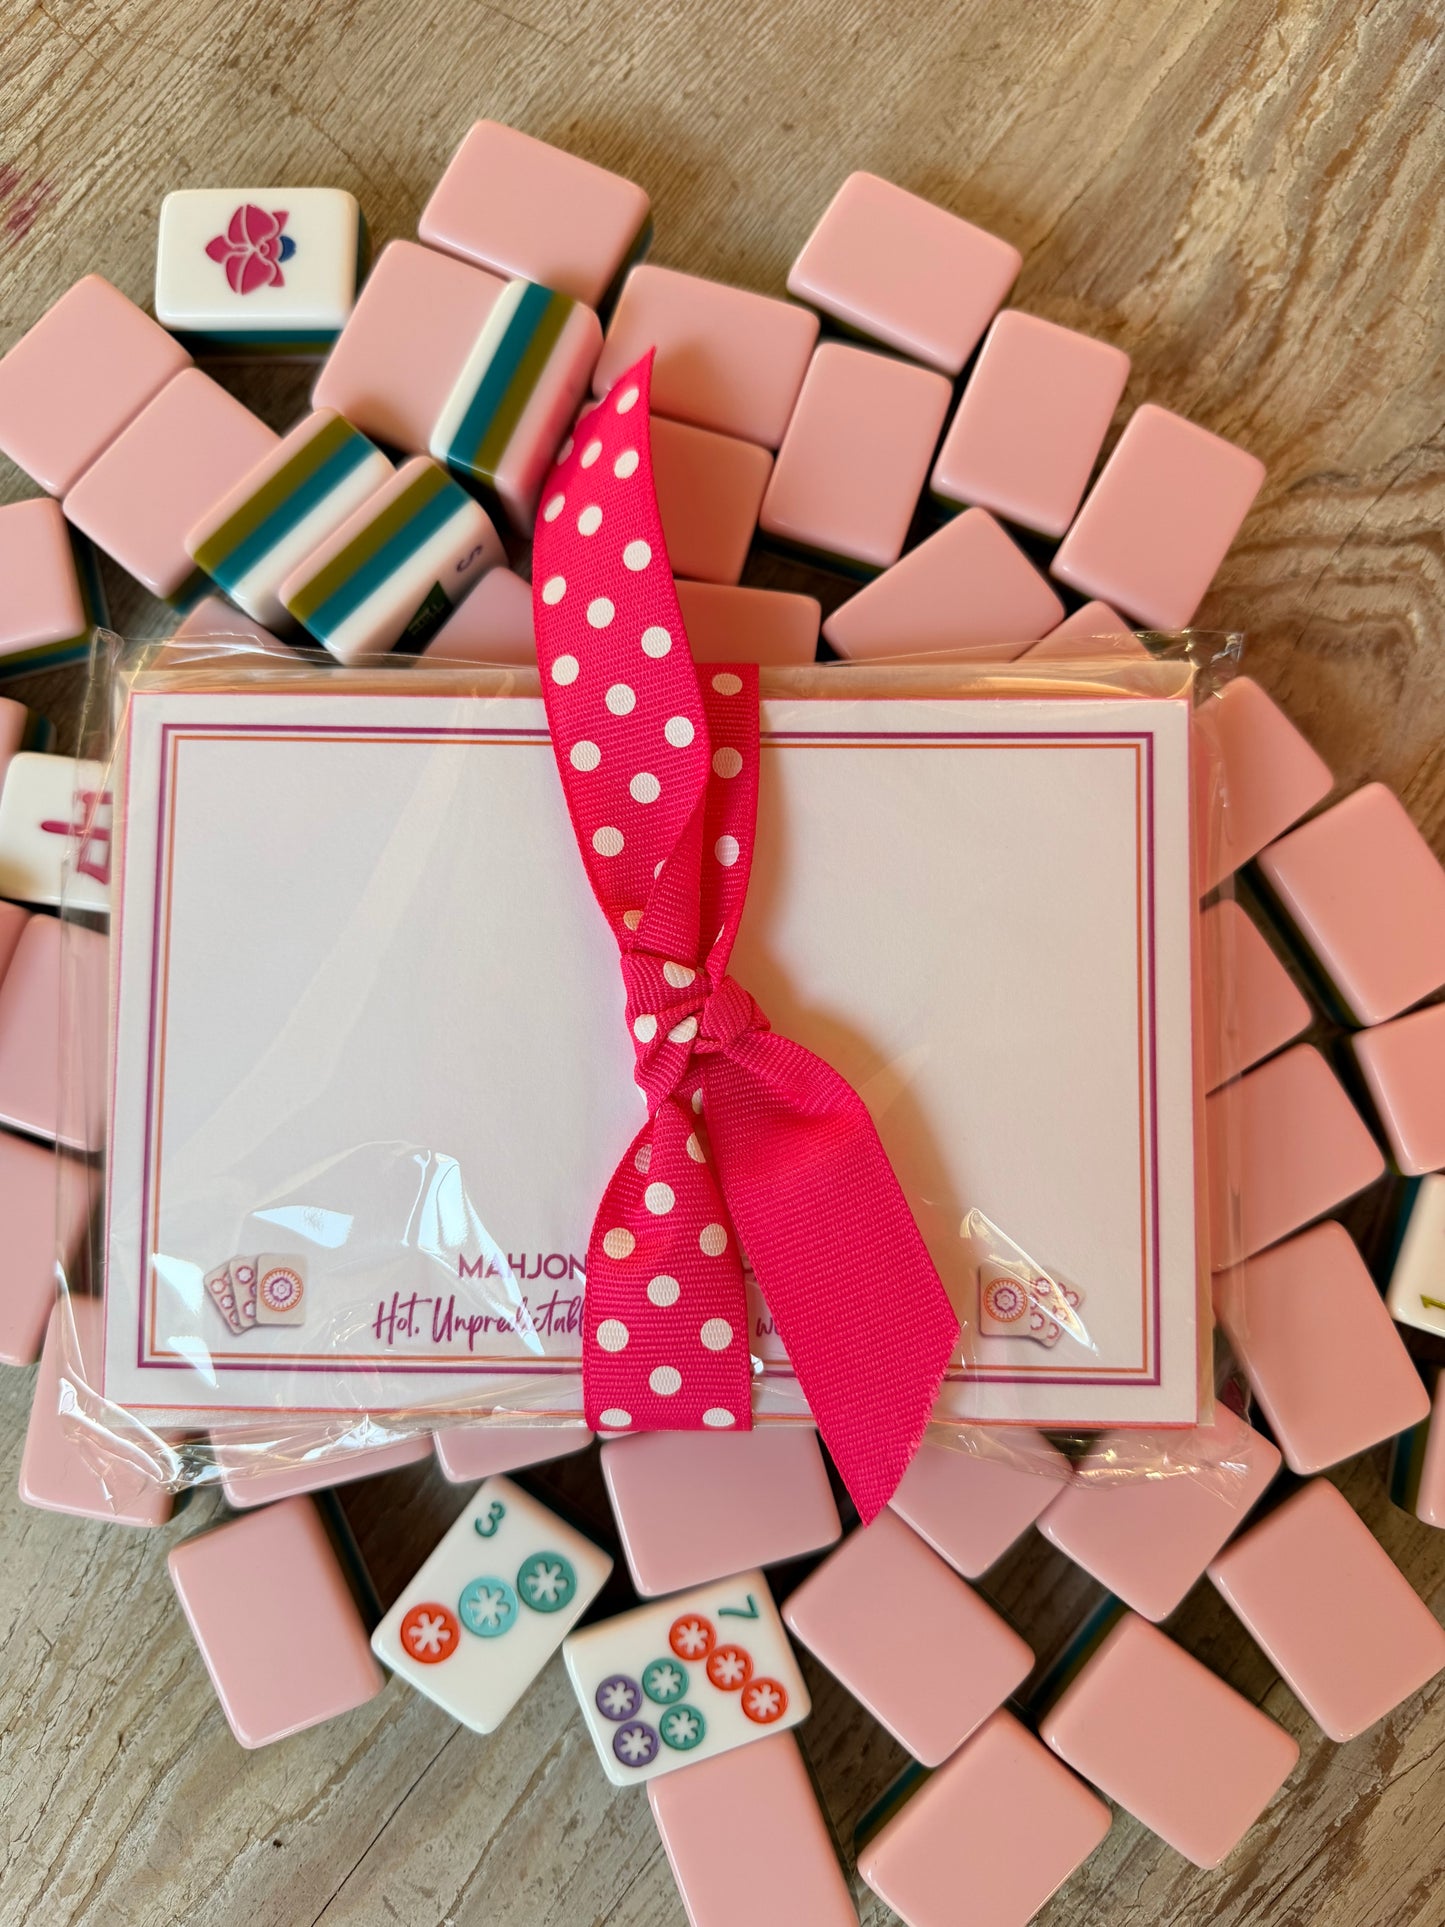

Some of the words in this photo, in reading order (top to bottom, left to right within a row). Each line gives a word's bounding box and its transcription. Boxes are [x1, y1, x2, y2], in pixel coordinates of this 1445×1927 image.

[458, 1252, 587, 1280] MAHJON
[372, 1291, 433, 1345] Hot.
[432, 1289, 586, 1352] Unpredctabl
[474, 1501, 506, 1538] 3
[718, 1593, 760, 1621] 7
